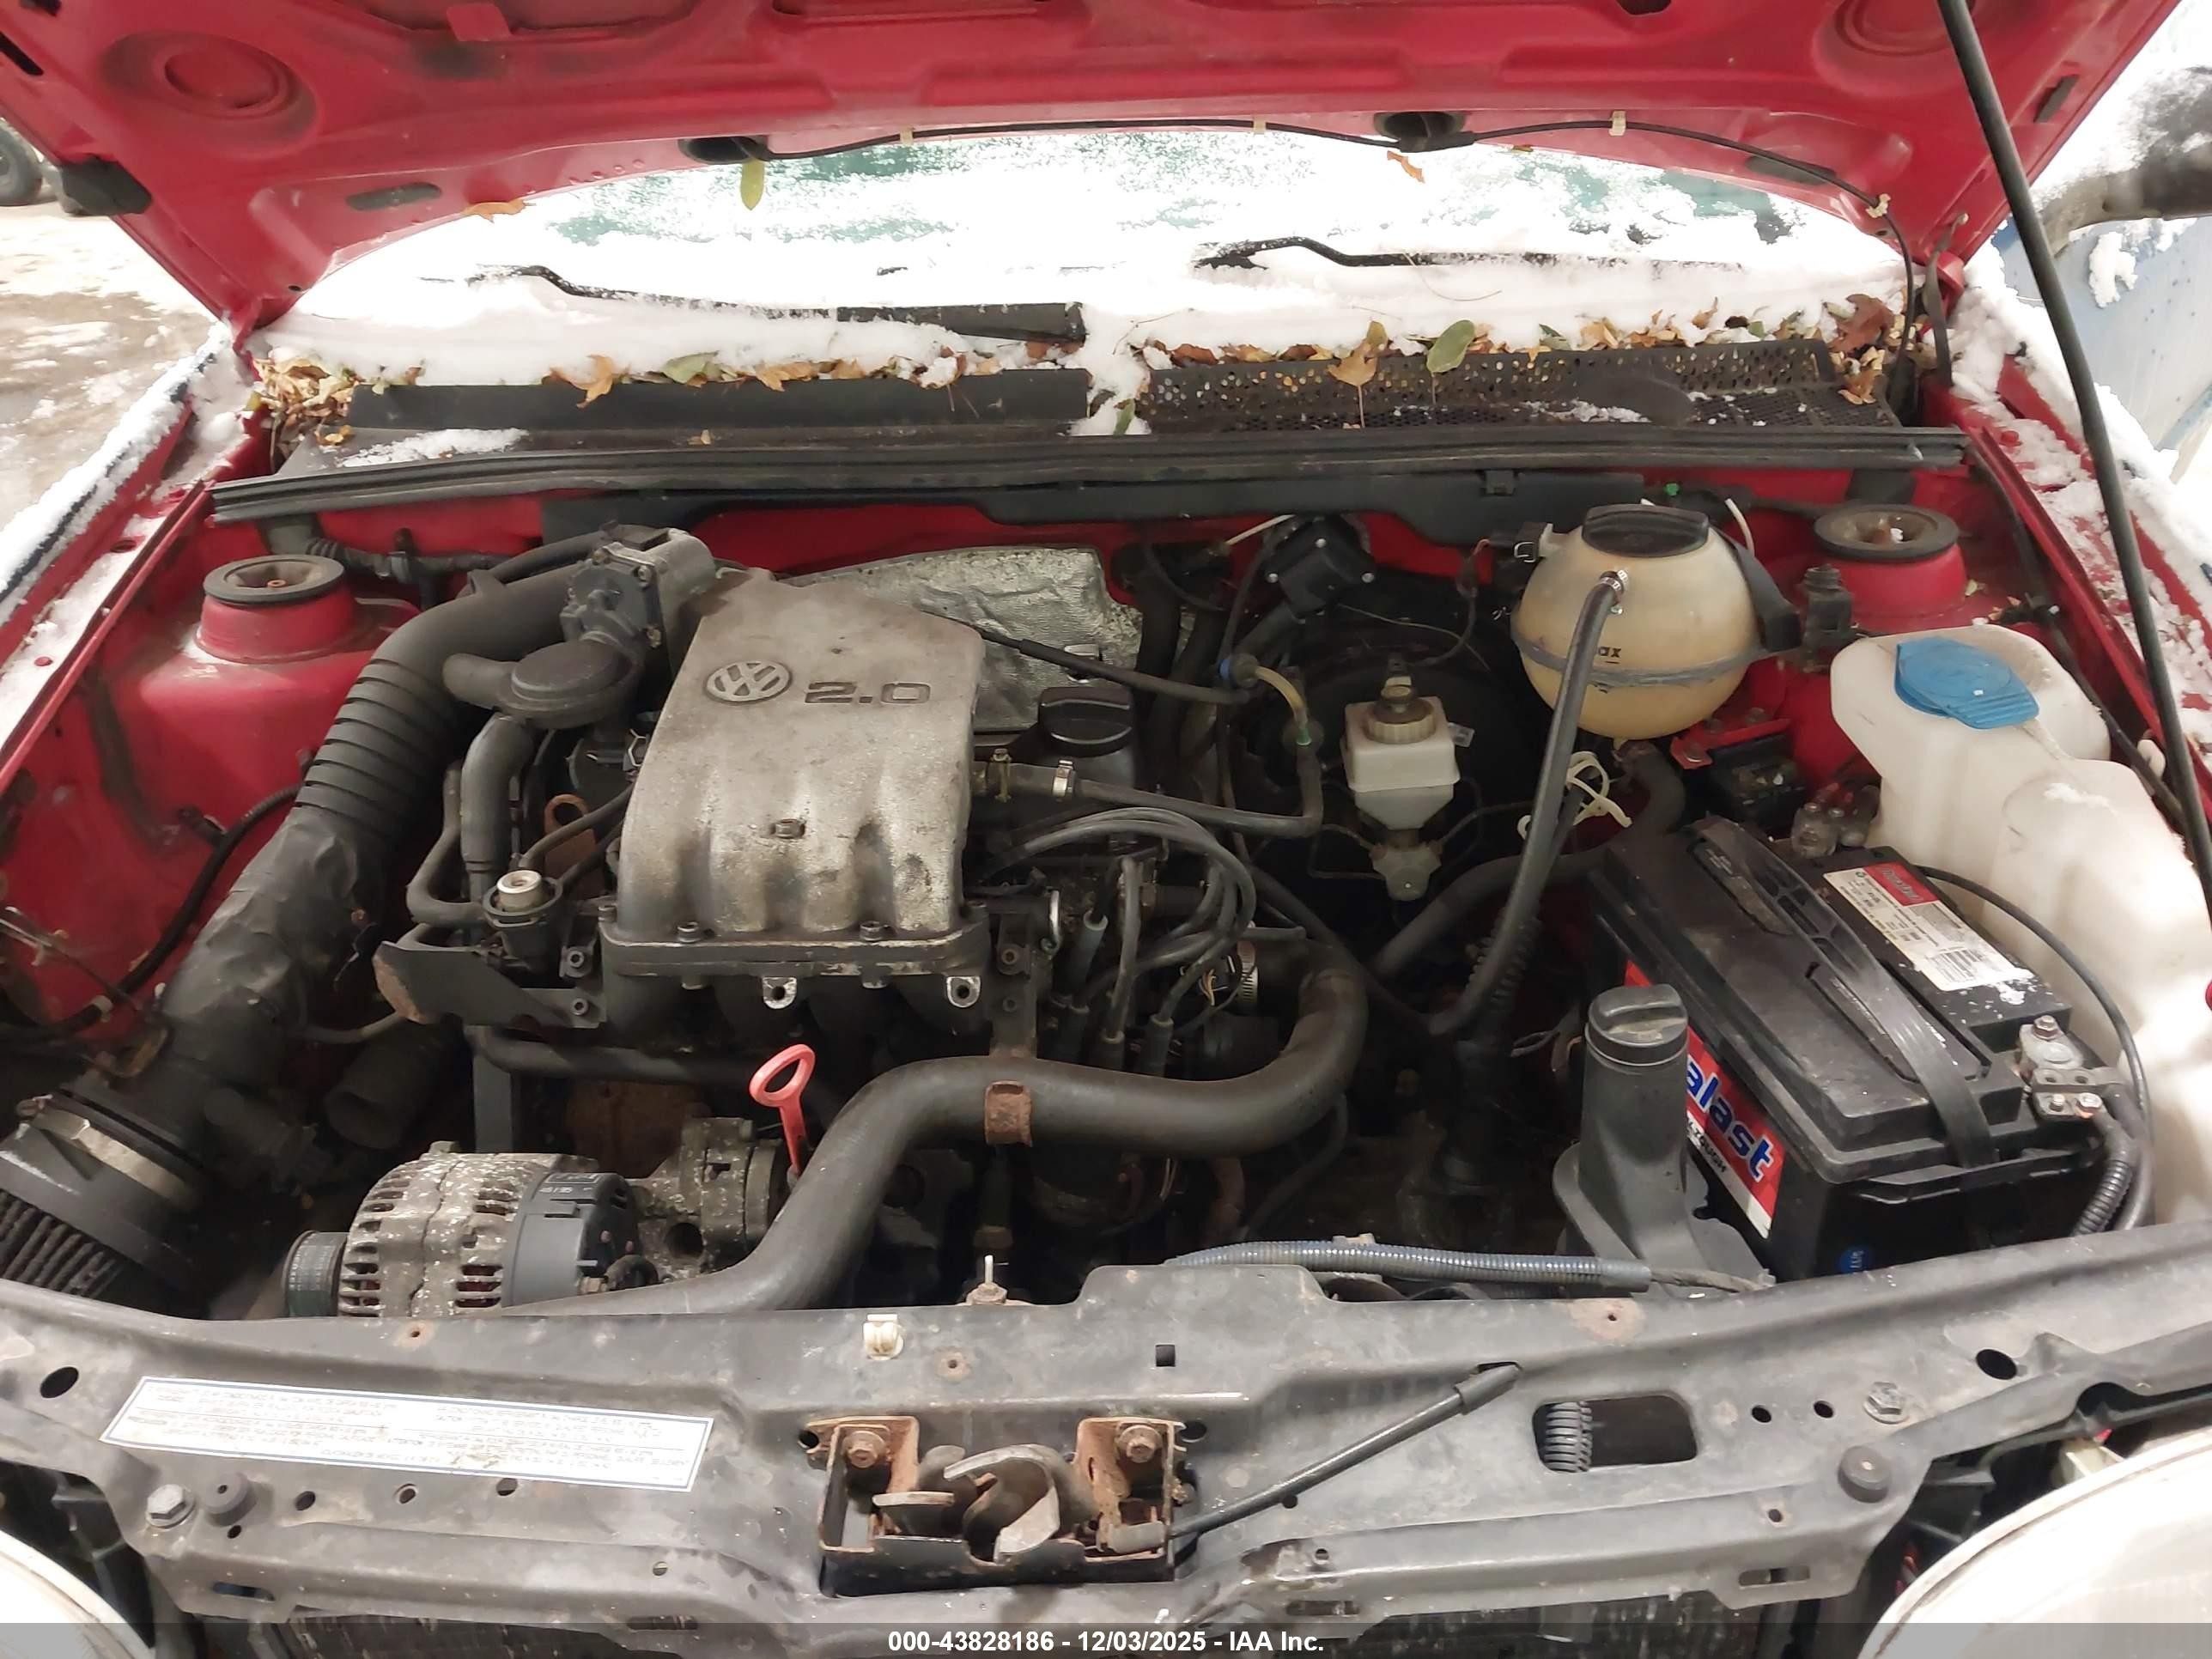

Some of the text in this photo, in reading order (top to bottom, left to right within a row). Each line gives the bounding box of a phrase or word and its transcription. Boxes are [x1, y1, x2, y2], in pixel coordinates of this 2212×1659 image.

[1599, 647, 1621, 658] ax
[805, 681, 930, 704] 2.0
[1686, 1058, 1772, 1181] alast
